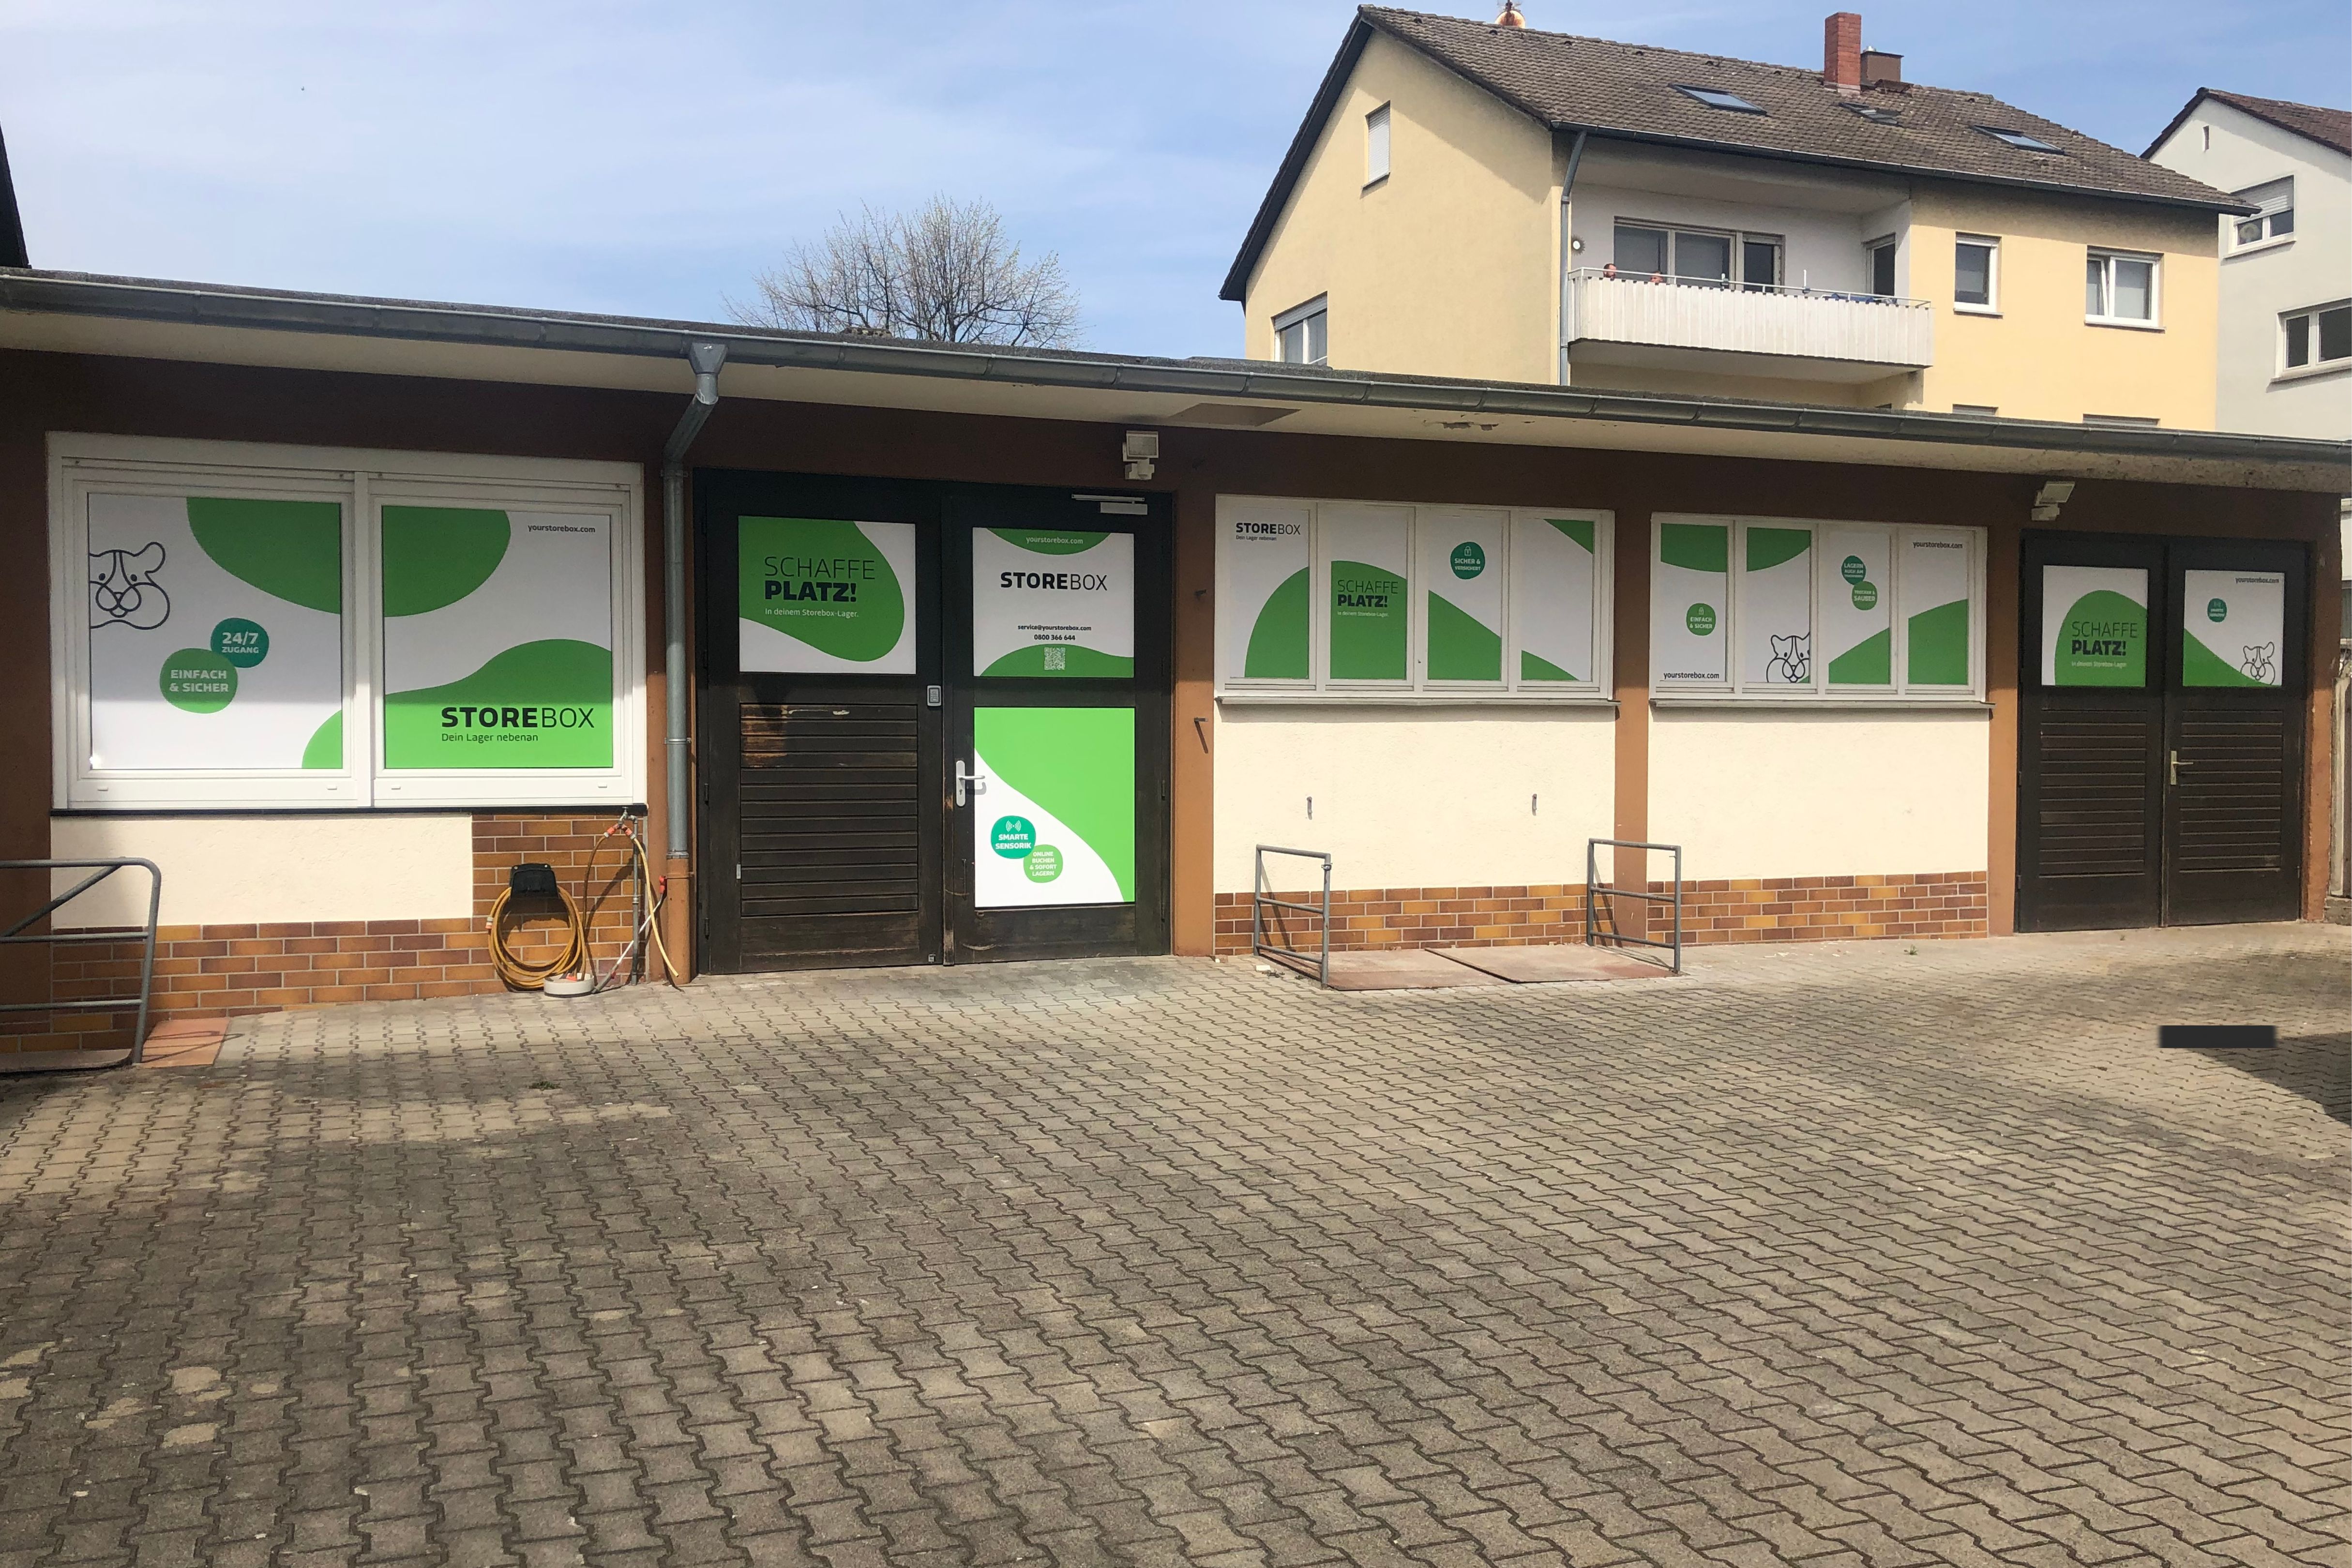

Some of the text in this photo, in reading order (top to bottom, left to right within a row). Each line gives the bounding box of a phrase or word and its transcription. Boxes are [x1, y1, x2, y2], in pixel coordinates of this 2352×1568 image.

[528, 524, 595, 533] yourstorebox.com
[1236, 523, 1300, 535] STOREBOX
[765, 557, 875, 580] SCHAFFE
[1001, 572, 1107, 590] STOREBOX
[1338, 580, 1398, 594] SCHAFFE
[765, 581, 856, 602] PLATZ!
[1338, 594, 1387, 607] PLATZ!
[802, 609, 859, 618] Storebox-Lager.
[2072, 621, 2137, 638] SCHAFFE
[222, 631, 257, 645] 24/7
[2072, 640, 2126, 655] PLATZ!
[171, 670, 227, 679] EINFACH
[169, 682, 228, 693] & SICHER
[441, 707, 594, 728] STOREBOX
[442, 733, 538, 744] Dein Lager nebenan
